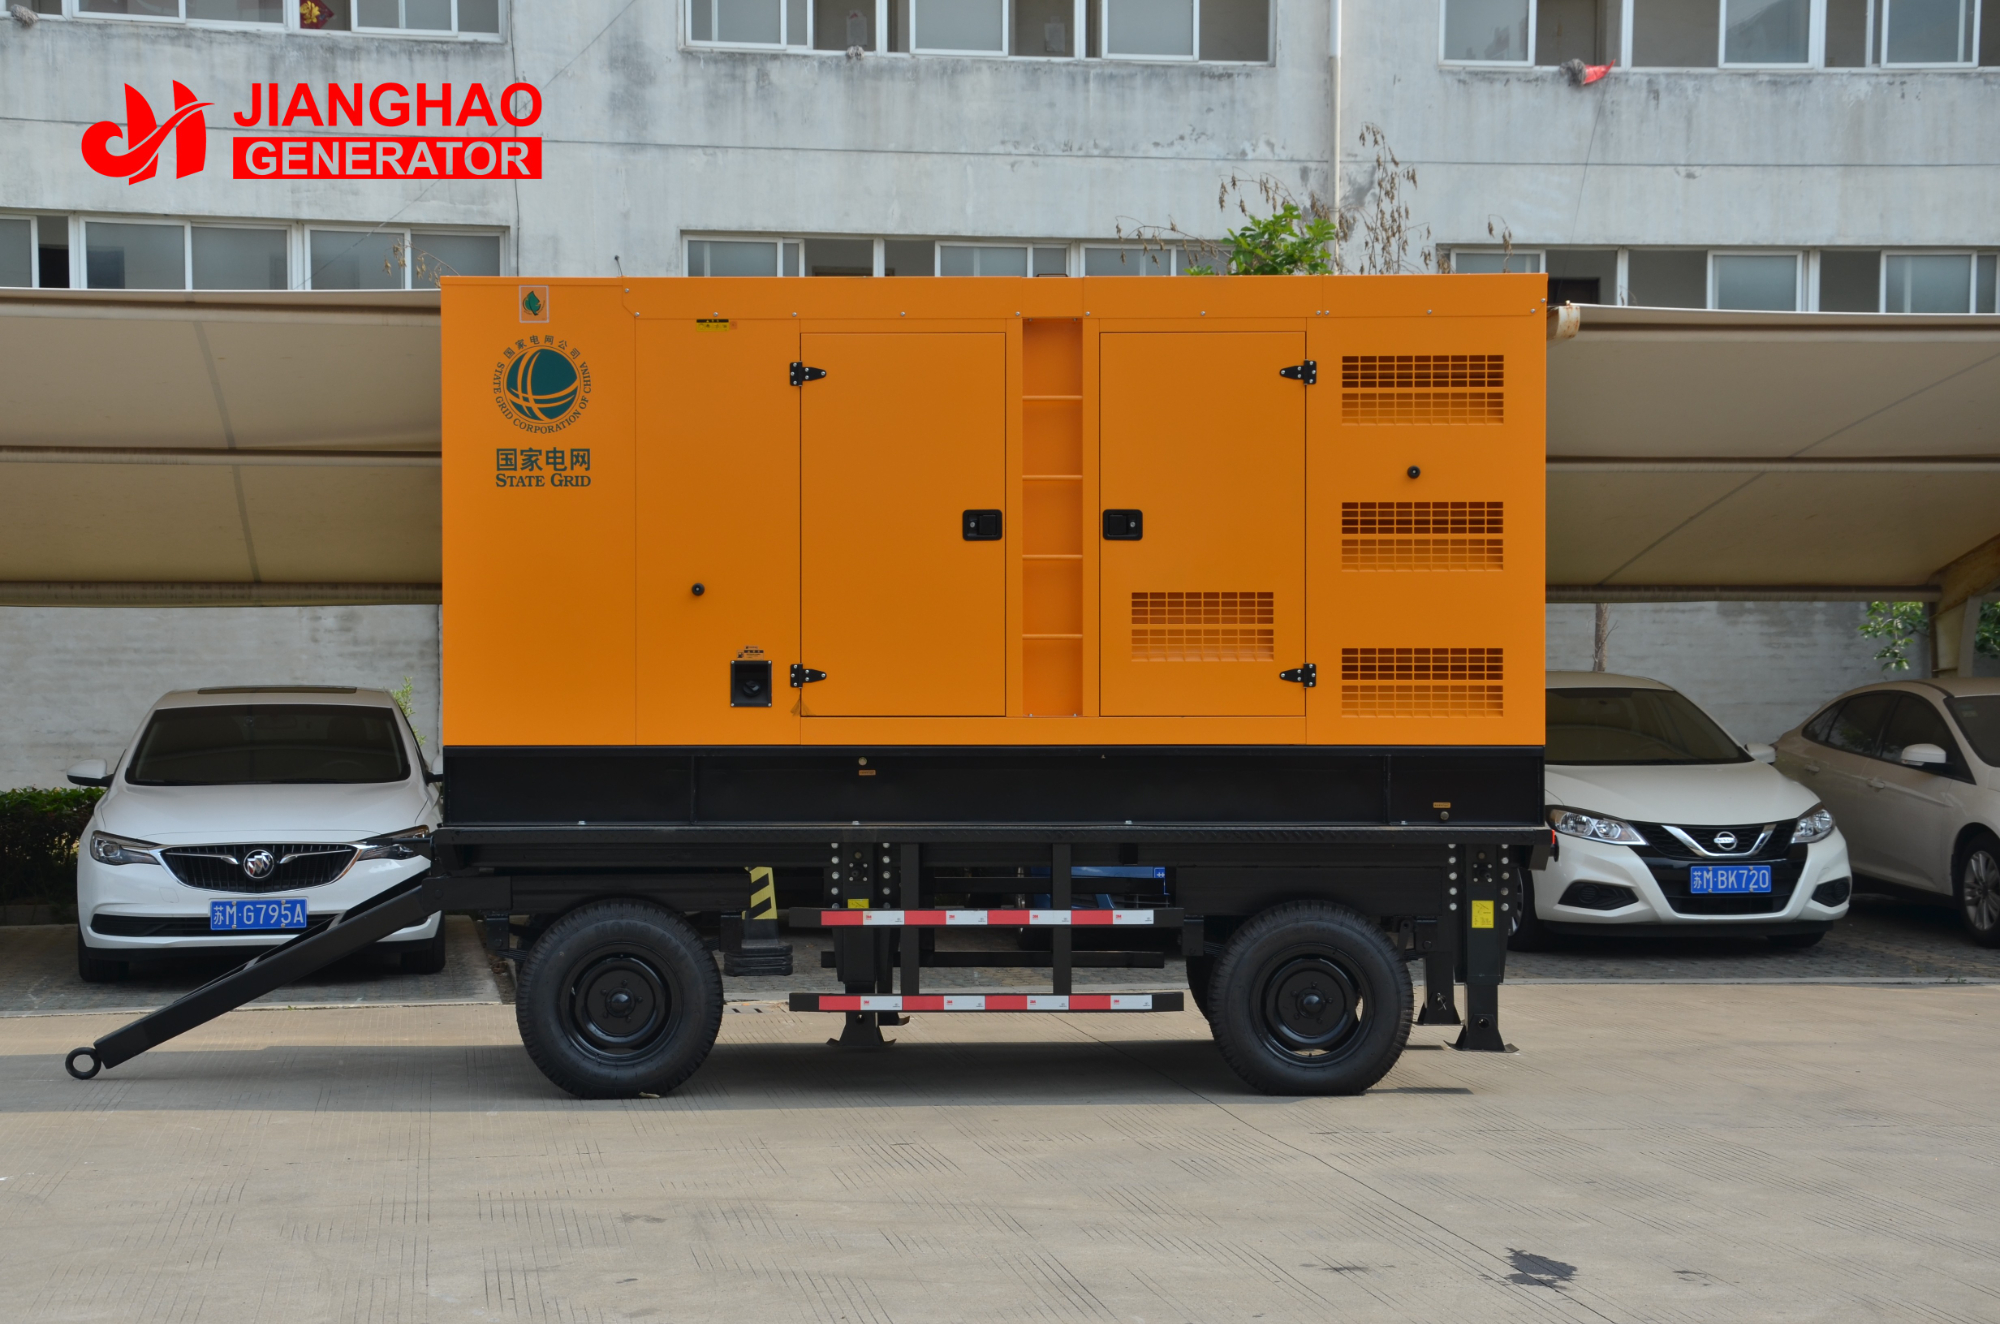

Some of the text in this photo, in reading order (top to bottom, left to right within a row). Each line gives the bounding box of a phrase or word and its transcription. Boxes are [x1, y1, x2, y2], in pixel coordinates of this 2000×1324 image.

[503, 334, 581, 360] 国家电网公司
[493, 361, 592, 434] STATE GRID CORPORATION OF CHINA
[496, 447, 591, 471] 国家电网
